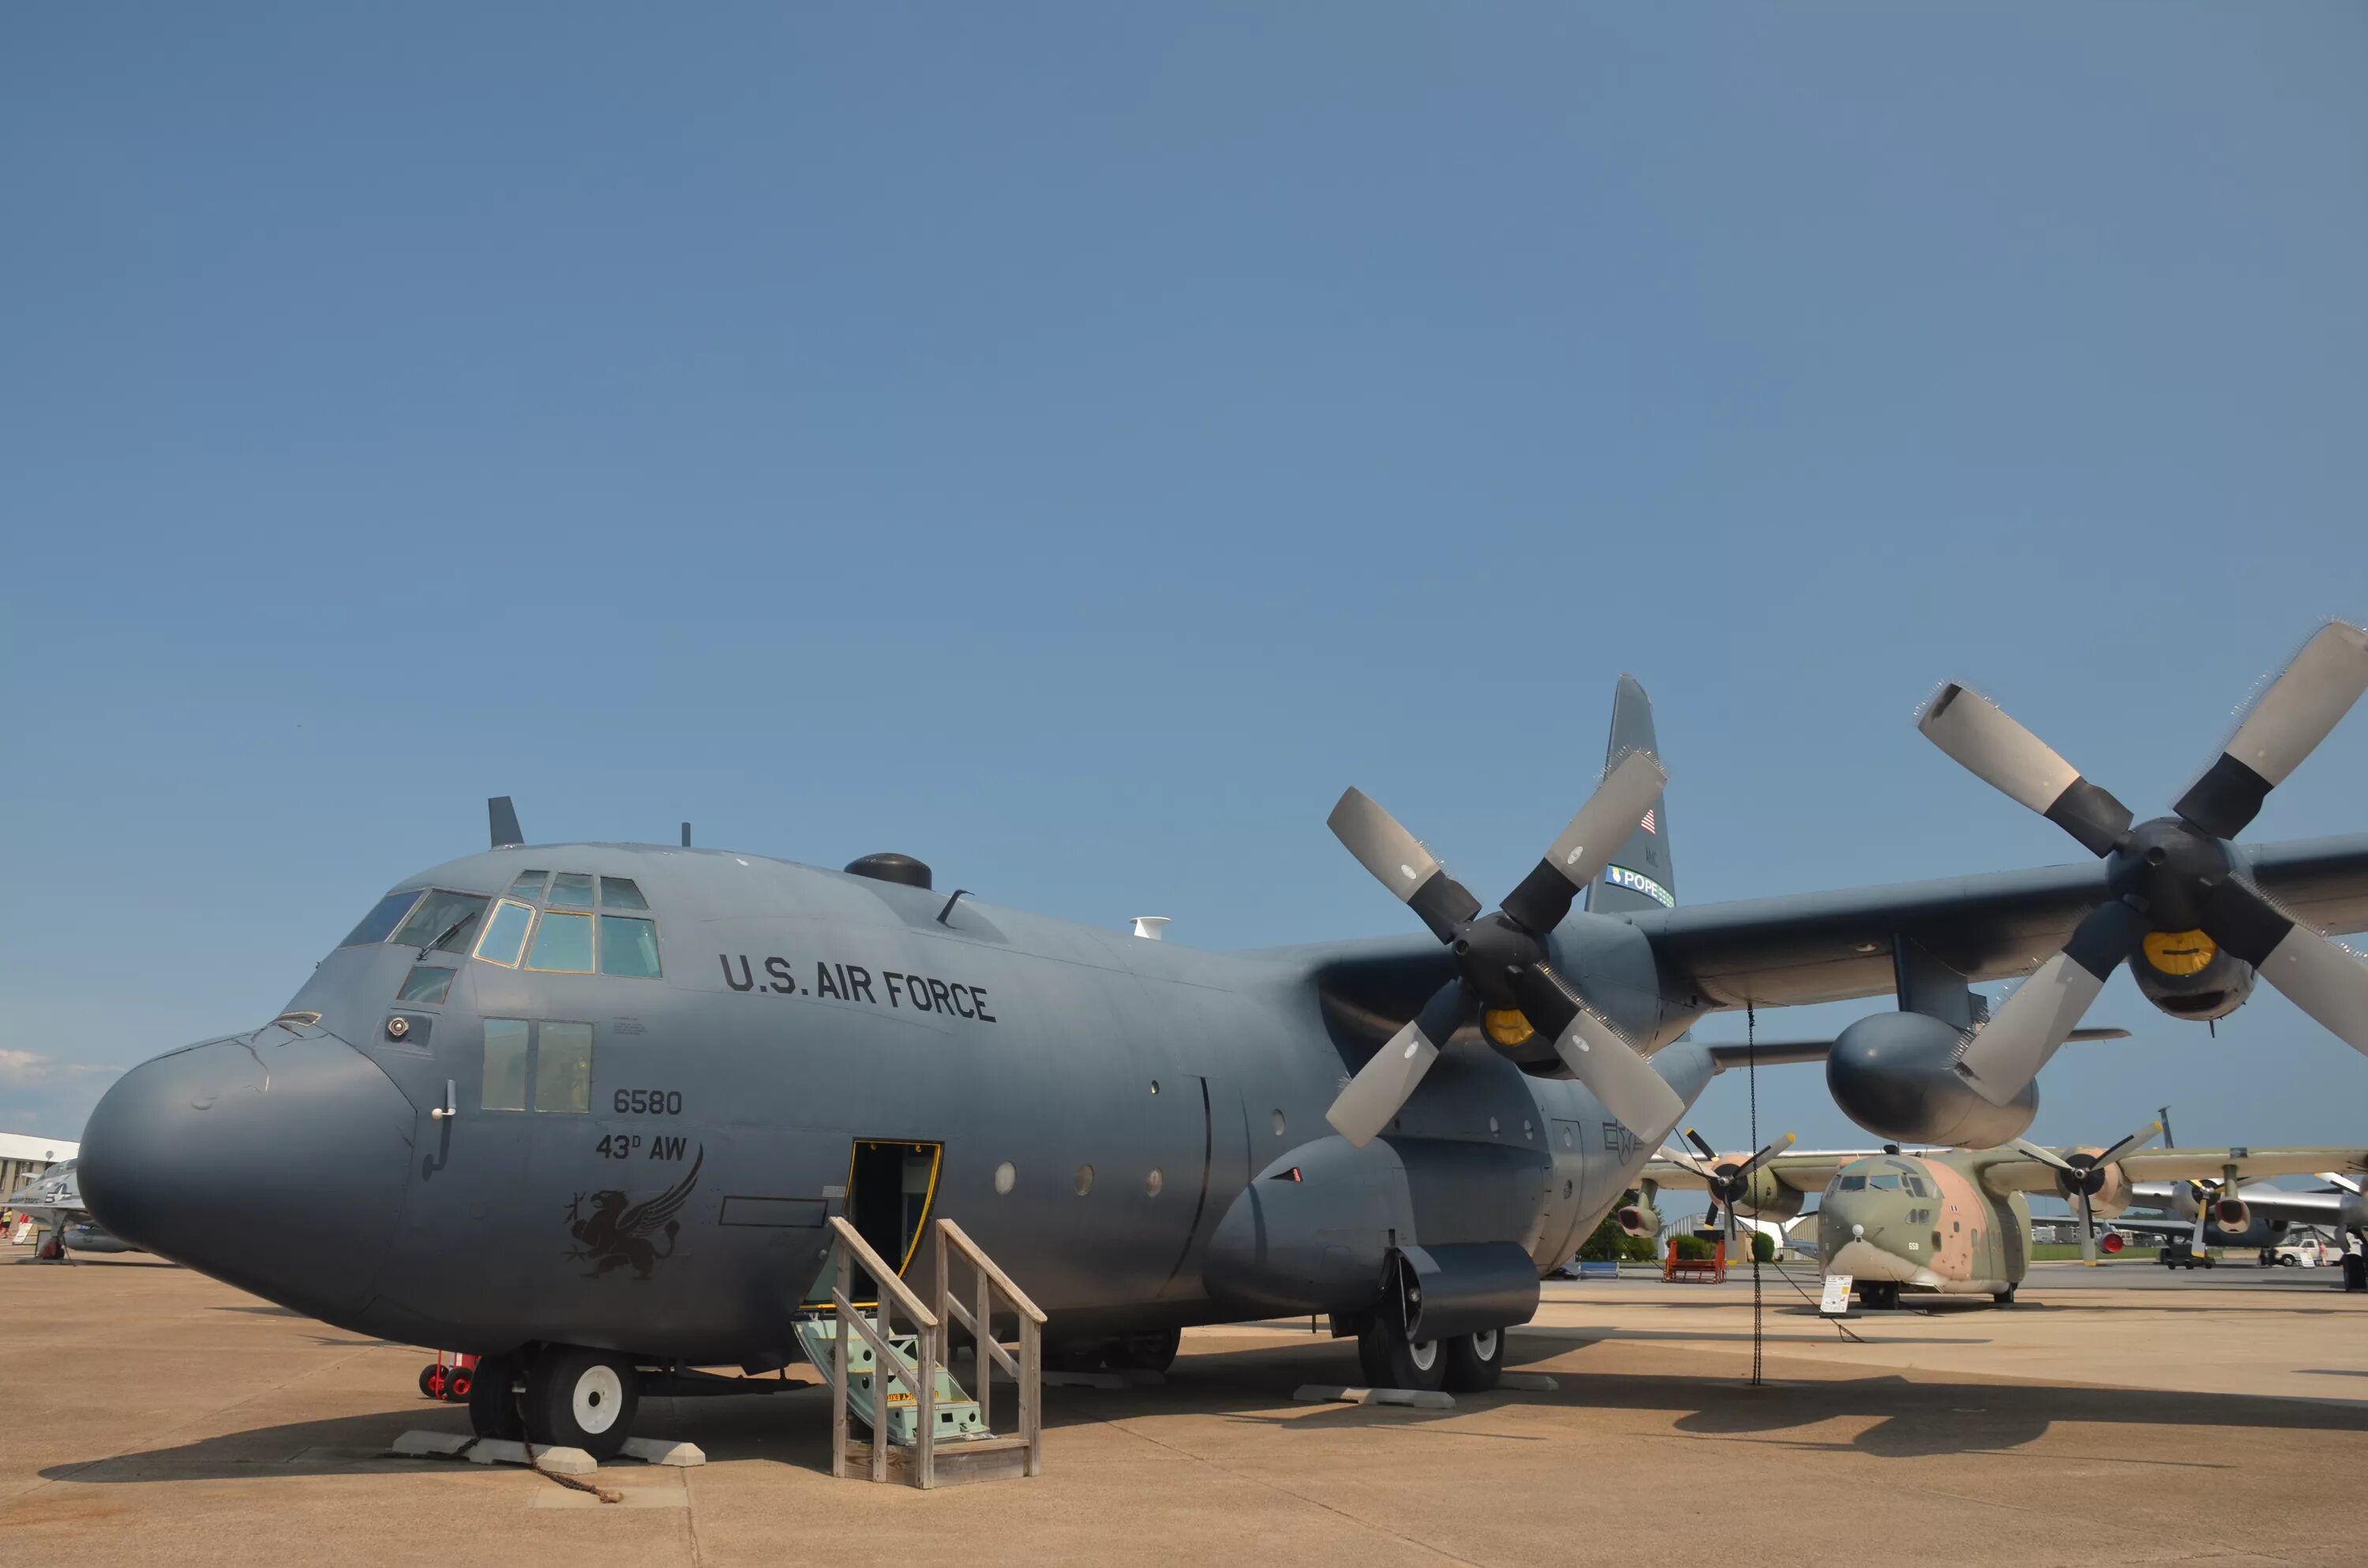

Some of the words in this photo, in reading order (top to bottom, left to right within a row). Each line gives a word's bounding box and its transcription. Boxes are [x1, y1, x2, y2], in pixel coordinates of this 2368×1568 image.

[1624, 872, 1658, 898] POPE
[719, 954, 809, 995] U.S.
[817, 961, 877, 1004] AIR
[882, 971, 996, 1023] FORCE
[614, 1089, 682, 1115] 6580
[649, 1136, 688, 1161] AW
